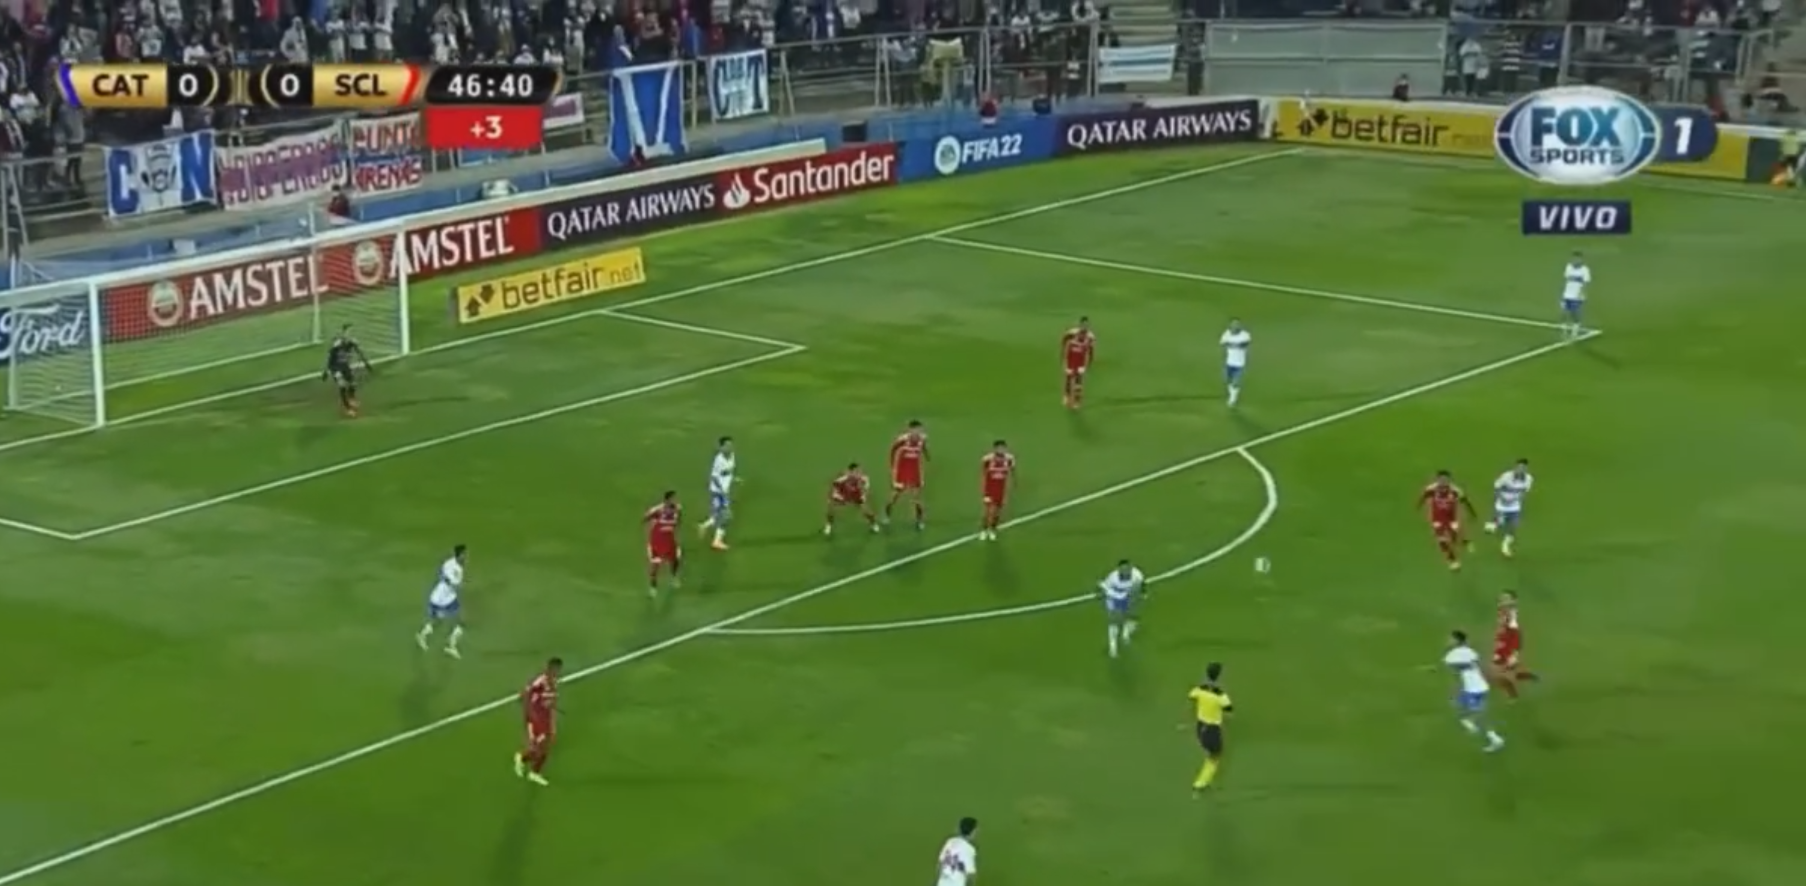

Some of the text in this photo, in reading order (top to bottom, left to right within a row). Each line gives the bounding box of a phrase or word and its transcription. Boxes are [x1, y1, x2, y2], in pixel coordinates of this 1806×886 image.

[962, 138, 999, 164] FIFA
[1000, 133, 1022, 157] 22
[1067, 108, 1253, 149] QATAR AIRWAYS
[1331, 111, 1450, 147] betfair
[752, 149, 895, 204] Santander
[547, 184, 715, 241] QATAR AIRWAYS
[389, 215, 514, 278] AMSTEL
[189, 254, 327, 320] AMSTEL
[501, 263, 606, 310] betfair
[0, 303, 84, 359] Ford
